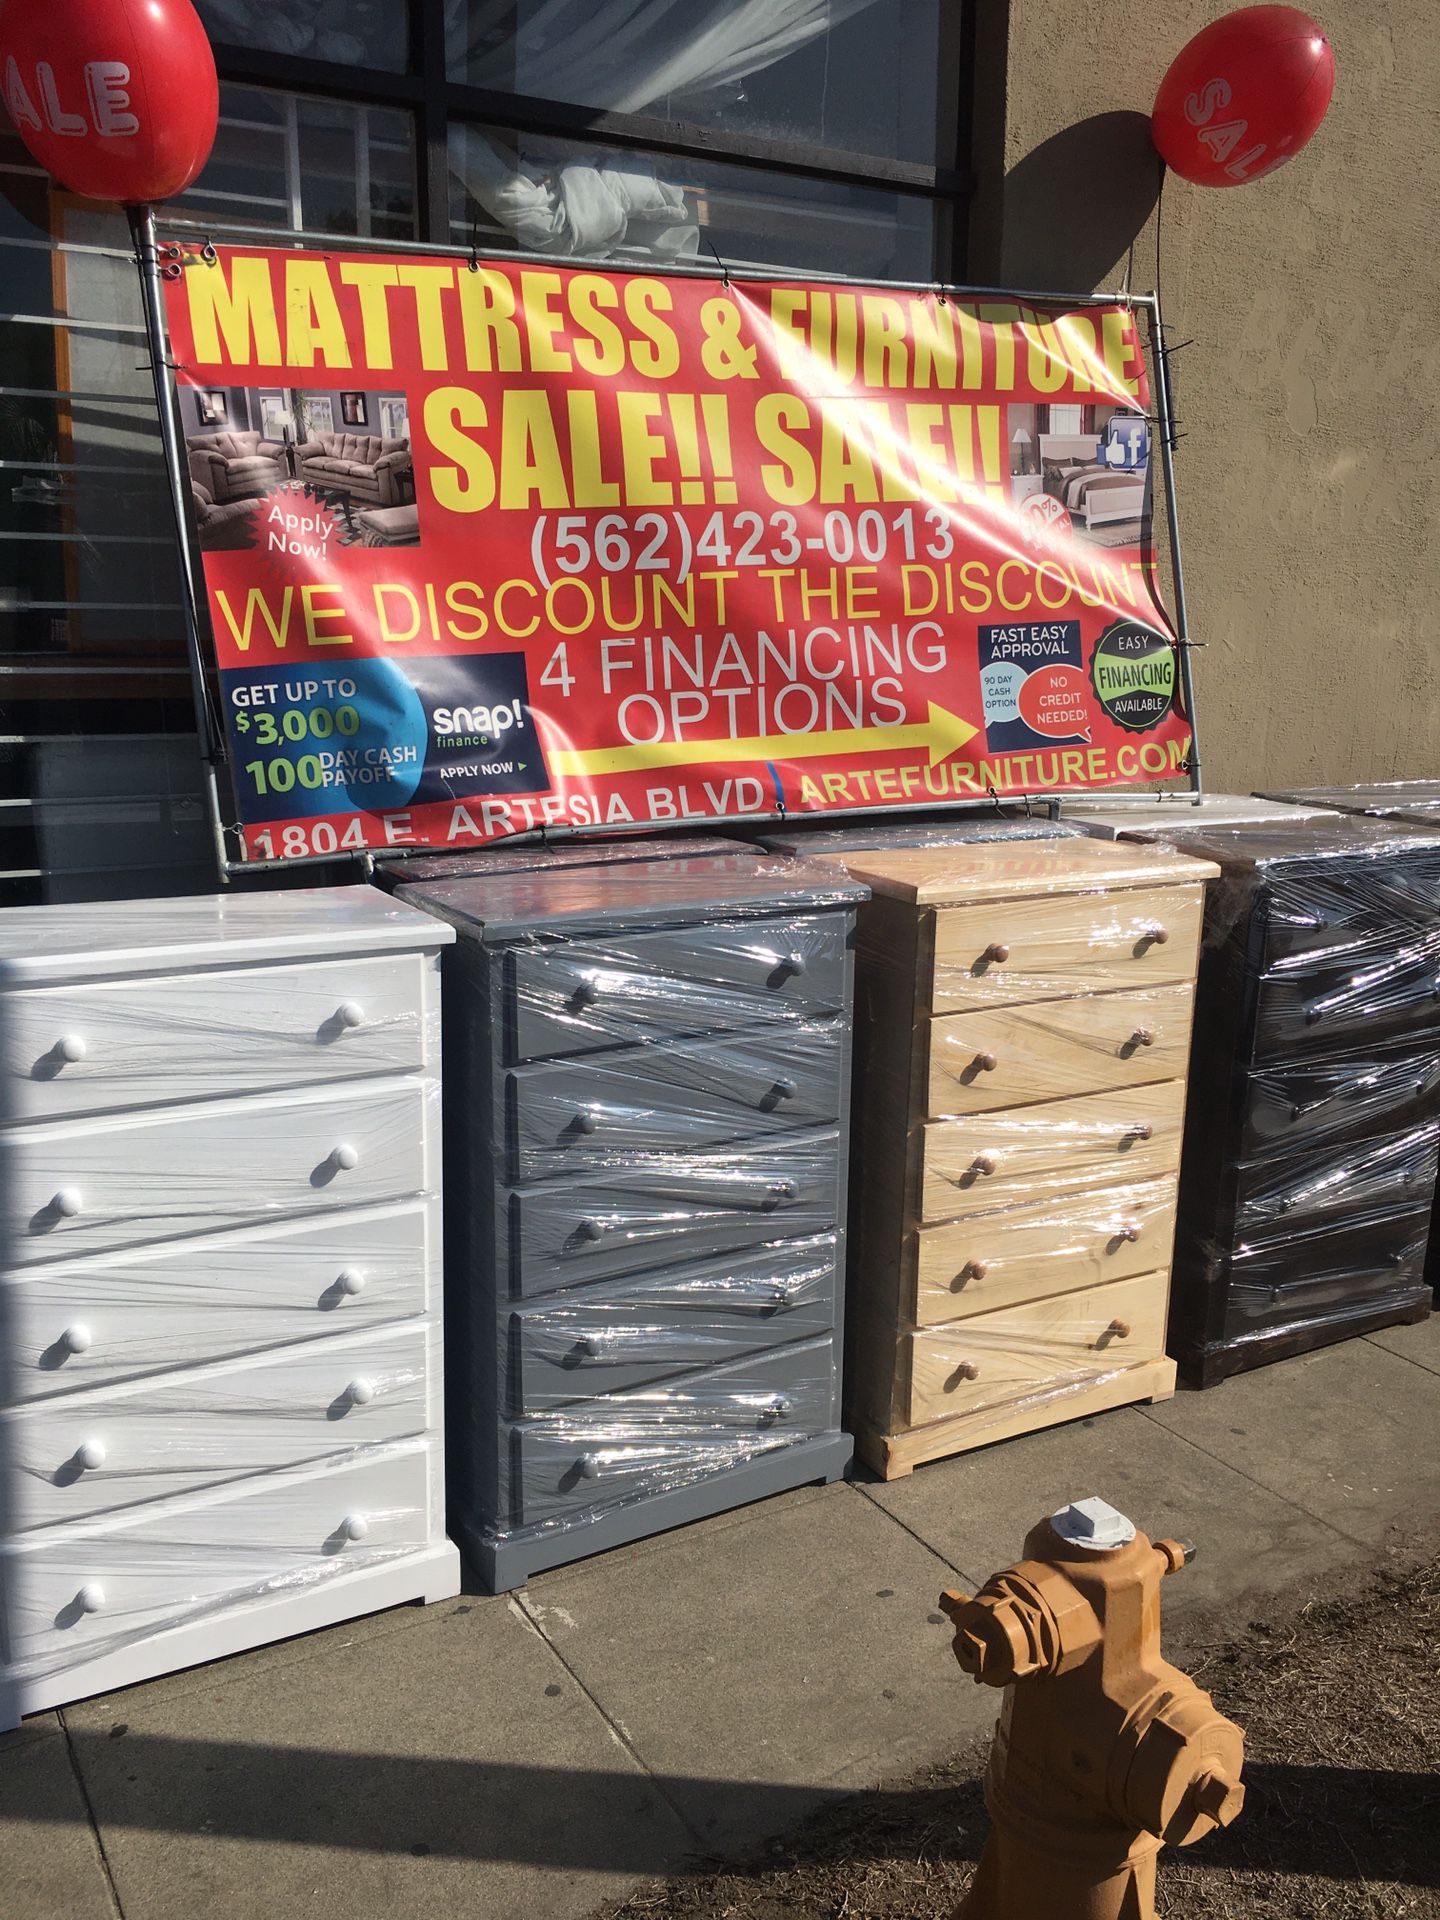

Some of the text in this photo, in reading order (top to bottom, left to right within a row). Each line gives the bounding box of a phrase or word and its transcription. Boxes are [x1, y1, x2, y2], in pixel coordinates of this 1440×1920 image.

[183, 256, 1139, 396] MATTRESS & FURNITURE
[423, 386, 1004, 513] SALE!! SALE!!
[268, 505, 333, 540] Apply
[268, 531, 327, 561] Now!
[531, 508, 955, 589] (562)423-0013
[215, 560, 1158, 651] WE DISCOUNT THE DISCOUNT
[991, 625, 1068, 643] FAST EASY
[1118, 635, 1149, 650] EASY
[540, 621, 947, 697] 4 FINANCING
[991, 641, 1069, 659] APPROVAL
[984, 675, 1013, 685] 90 DAY
[1049, 676, 1068, 688] NO
[1098, 662, 1171, 689] FINANCING
[231, 678, 356, 707] GET UP TO
[985, 699, 1017, 708] OPTION
[988, 687, 1011, 696] CASH
[1039, 692, 1082, 707] CREDIT
[1114, 697, 1163, 714] AVAILABLE
[235, 705, 360, 745] $3,000
[433, 699, 524, 739] snap!
[618, 677, 906, 745] OPTIONS
[1036, 710, 1088, 724] NEEDED!
[437, 735, 488, 748] finance
[245, 746, 417, 795] 100 DAY CASH
[322, 766, 396, 787] PAYOFF
[440, 761, 513, 779] APPLY NOW
[800, 736, 1192, 804] ARTEFURNITURE.COM
[254, 777, 765, 859] 1804 E. ARTESIA BLVD
